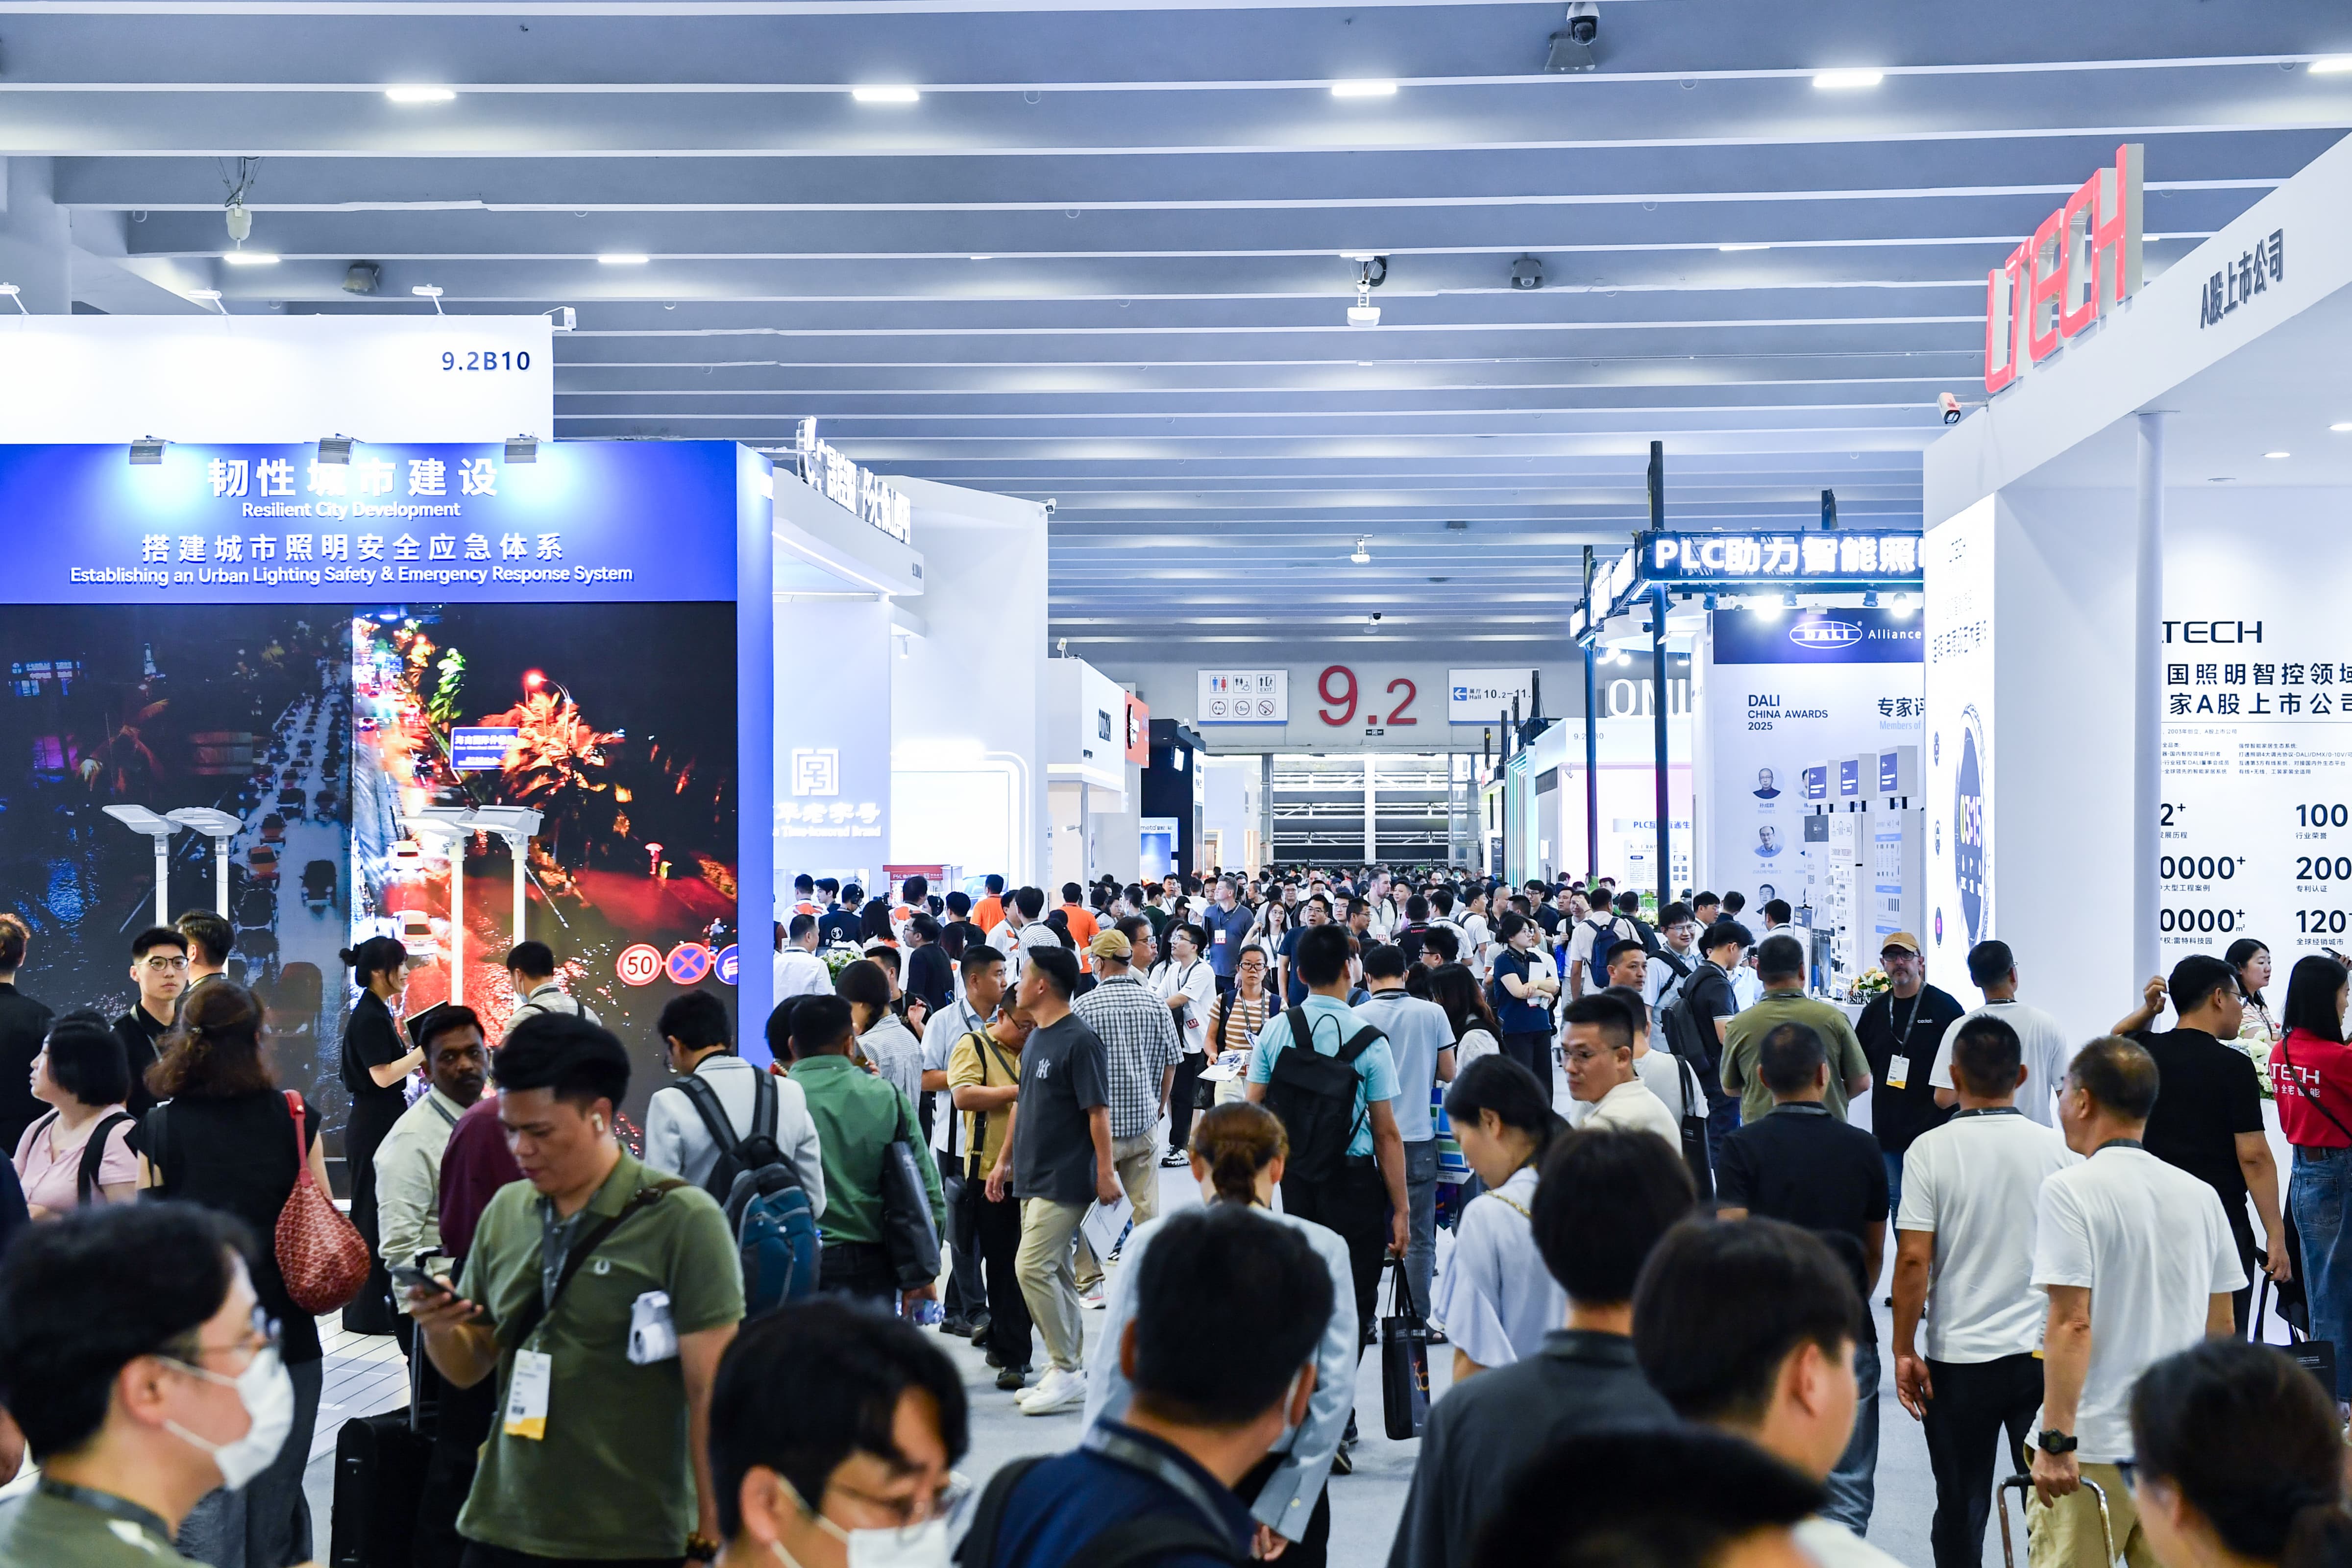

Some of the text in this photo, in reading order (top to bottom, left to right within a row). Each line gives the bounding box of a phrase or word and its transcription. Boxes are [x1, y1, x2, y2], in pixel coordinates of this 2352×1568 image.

[2200, 228, 2284, 329] A股上市公司
[441, 350, 531, 371] 9.2B10
[207, 457, 498, 497] 韧性城市建设
[242, 501, 461, 521] Resilient City Development
[142, 532, 564, 564] 搭建城市照明安全应急体系
[1655, 536, 1924, 574] PLC助力智能照
[70, 565, 634, 588] Establishing an Urban Lighting Safety & Emergency Response System
[1868, 629, 1922, 640] Alliance
[2162, 621, 2262, 643] TECH
[1318, 665, 1417, 726] 9.2
[1748, 694, 1781, 707] DALI
[1748, 710, 1828, 719] CHINA AWARDS
[1880, 720, 1921, 730] Members of
[1748, 721, 1773, 731] 2025
[1634, 820, 1690, 829] PLC互通生
[1960, 794, 1982, 848] 03:15
[2296, 857, 2352, 881] 200
[628, 956, 652, 975] 50
